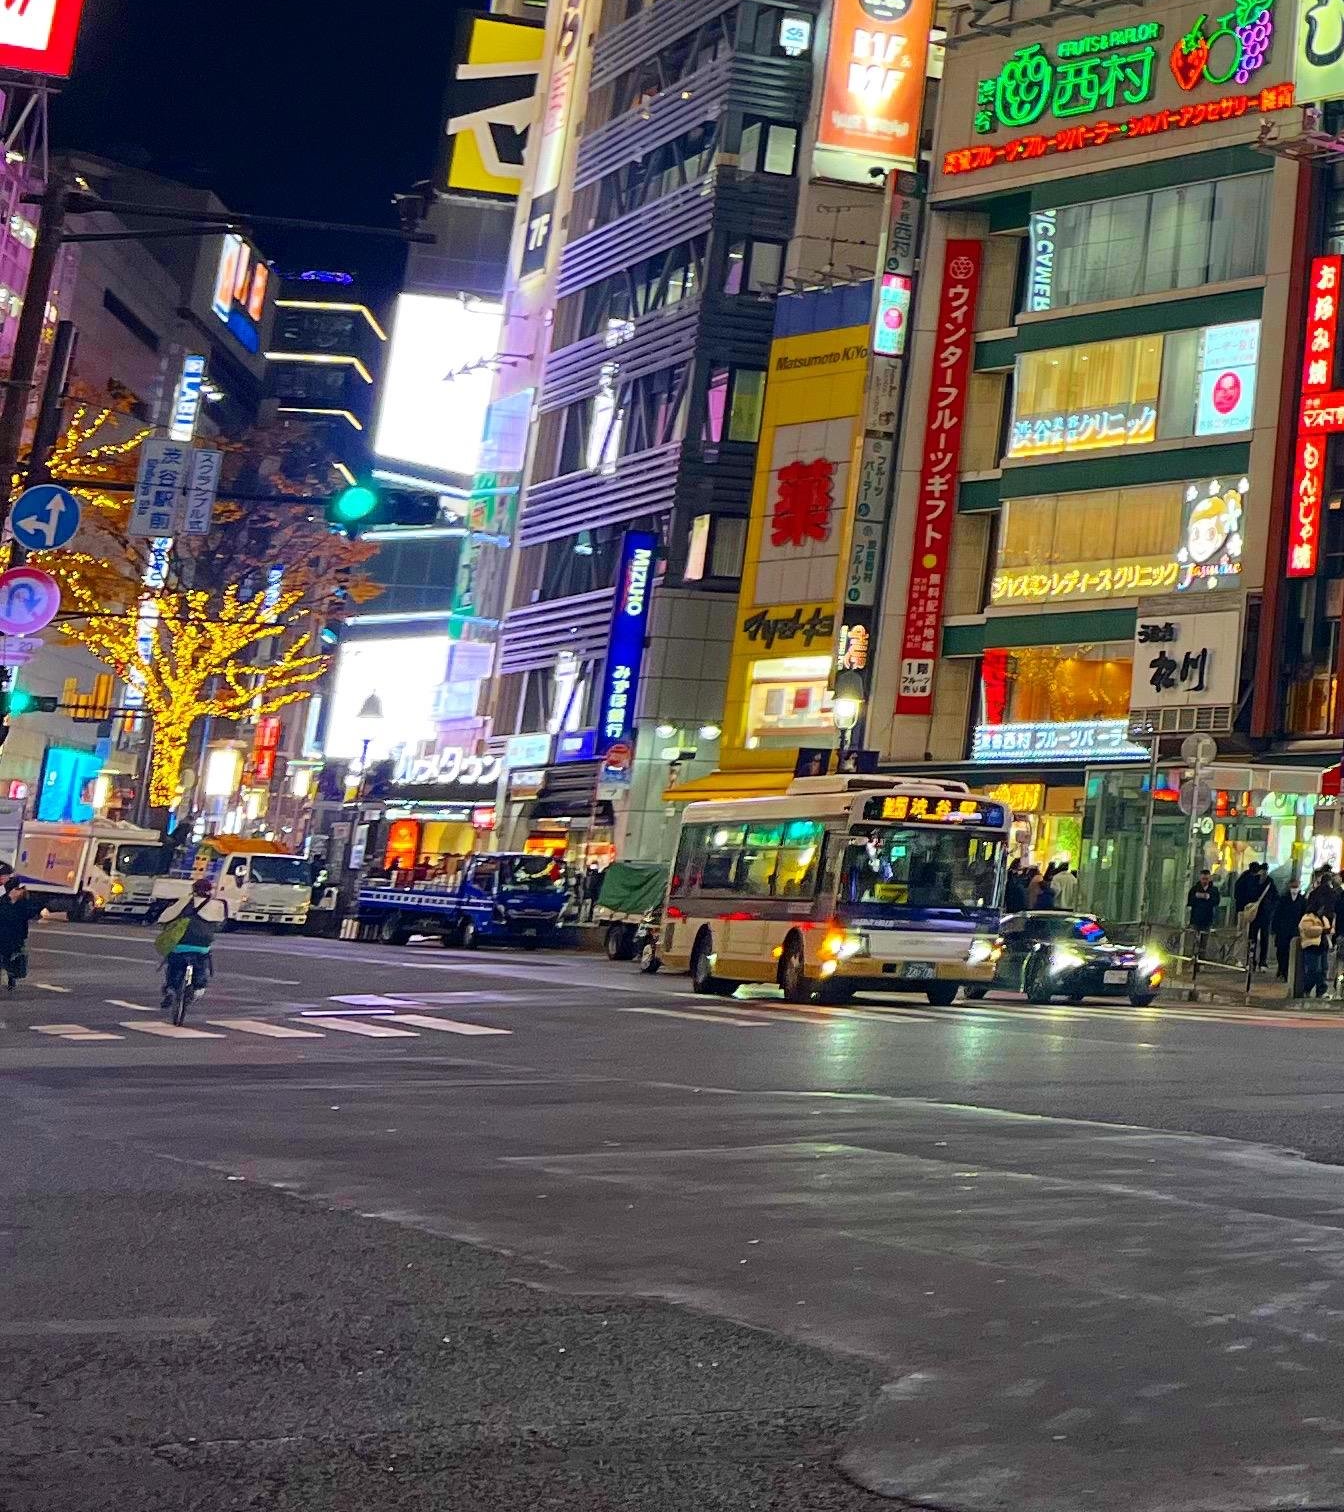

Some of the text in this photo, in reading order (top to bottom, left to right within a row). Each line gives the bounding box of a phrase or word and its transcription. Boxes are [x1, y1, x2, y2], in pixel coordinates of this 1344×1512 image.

[1053, 46, 1156, 118] 西村
[776, 351, 840, 371] Matsumoto
[772, 458, 835, 546] 薬
[626, 548, 652, 616] MIZUHO
